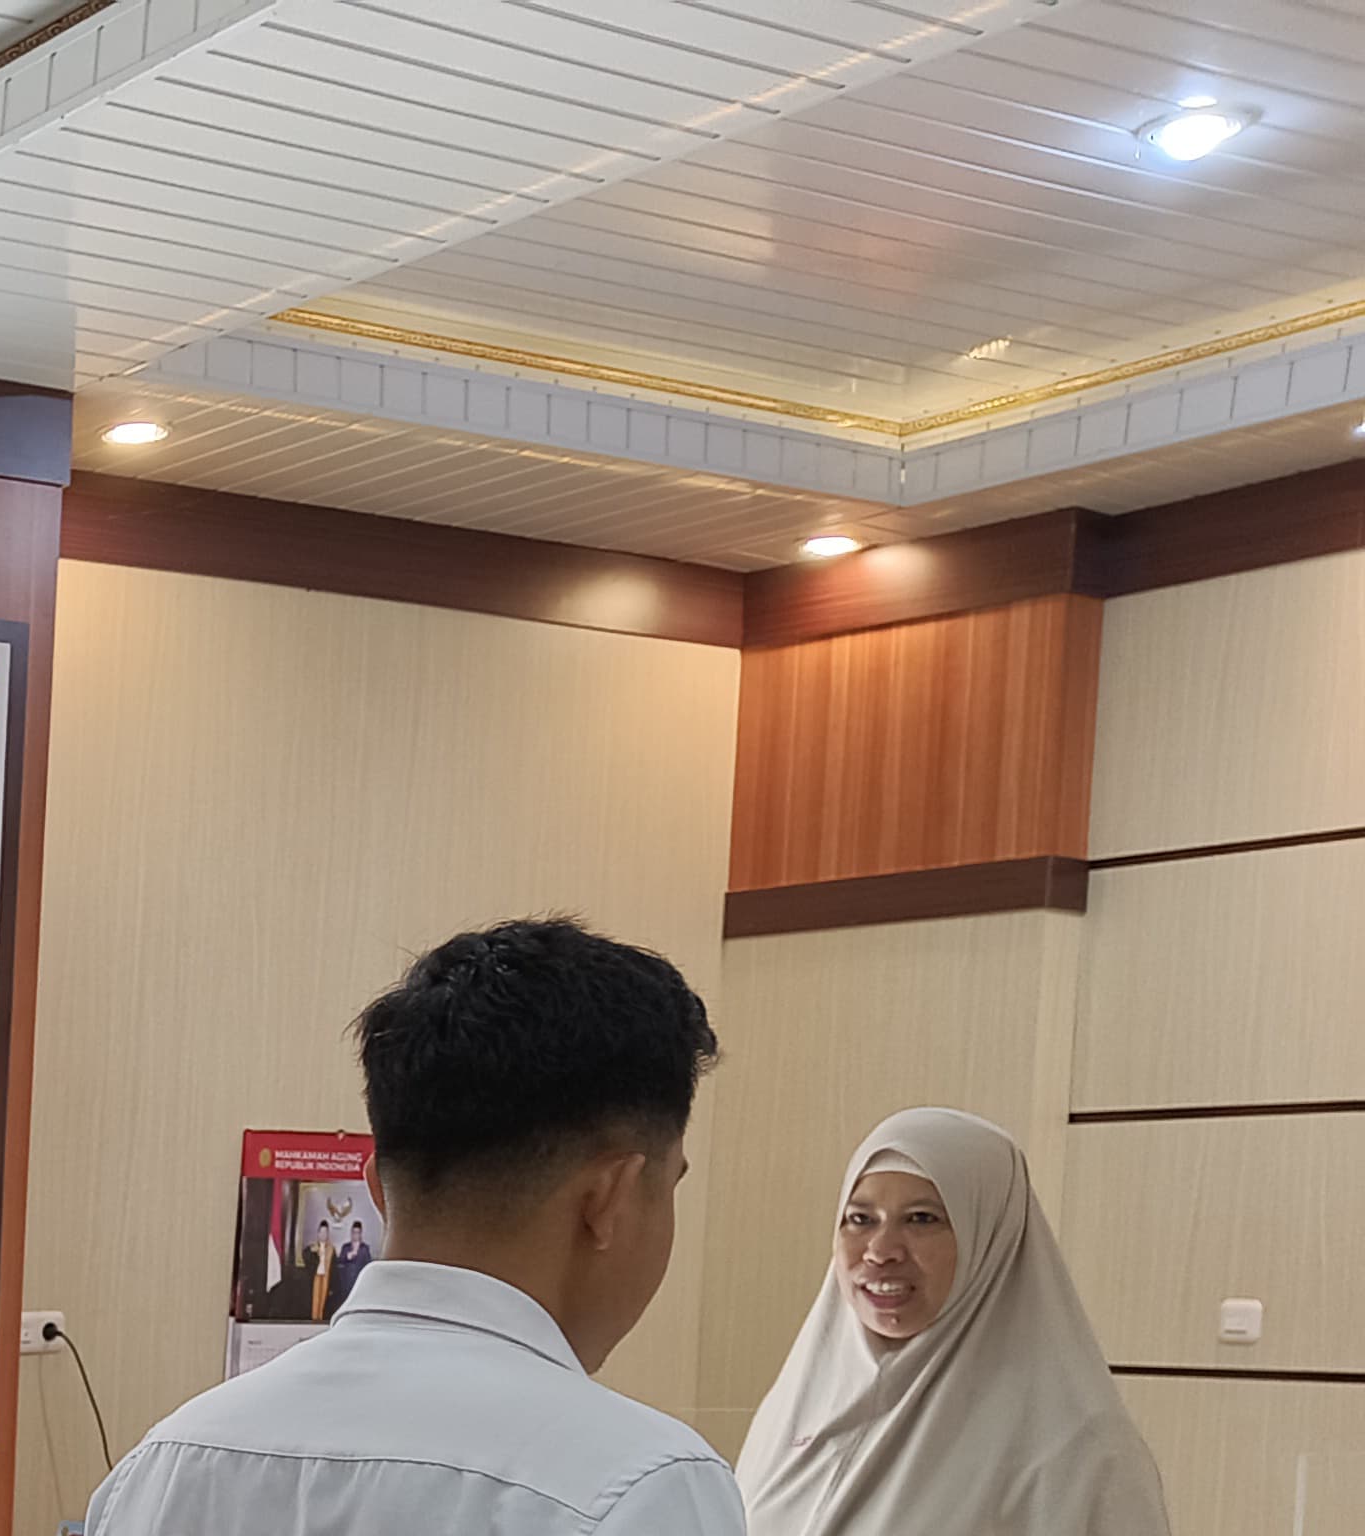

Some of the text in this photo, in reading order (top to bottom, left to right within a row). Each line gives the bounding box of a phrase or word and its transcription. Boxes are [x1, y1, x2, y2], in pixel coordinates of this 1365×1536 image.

[274, 1150, 362, 1162] MAHKAMAH AGUNG
[274, 1160, 314, 1169] REPUBLIK
